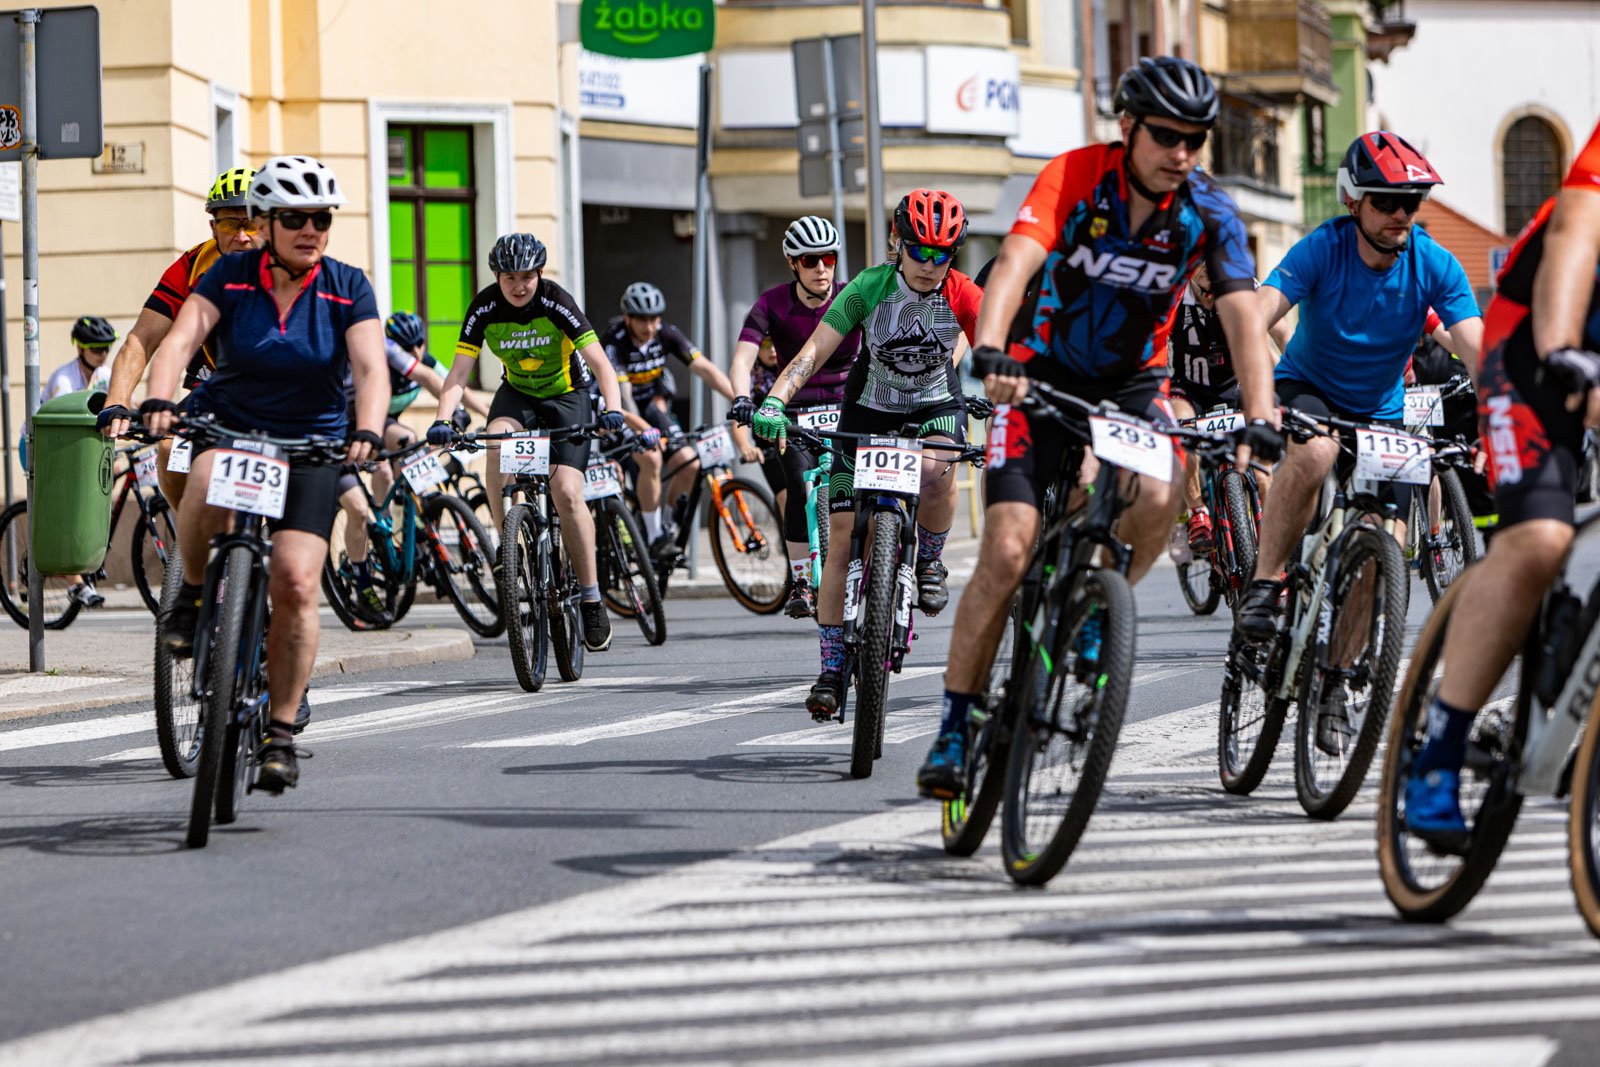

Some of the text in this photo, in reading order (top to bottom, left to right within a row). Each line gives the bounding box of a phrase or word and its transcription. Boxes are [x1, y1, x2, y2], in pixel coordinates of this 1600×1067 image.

[594, 0, 701, 30] żabka
[1067, 244, 1177, 288] NSR
[499, 335, 551, 350] WALIM
[807, 412, 839, 426] 160
[1206, 416, 1236, 433] 447
[988, 403, 1011, 470] NSR
[1108, 423, 1157, 449] 293
[1364, 434, 1422, 456] 1151
[1487, 395, 1523, 485] NSR
[515, 440, 536, 455] 53
[221, 456, 282, 488] 1153
[406, 457, 438, 479] 2712
[861, 450, 917, 472] 1012
[831, 499, 852, 510] quest
